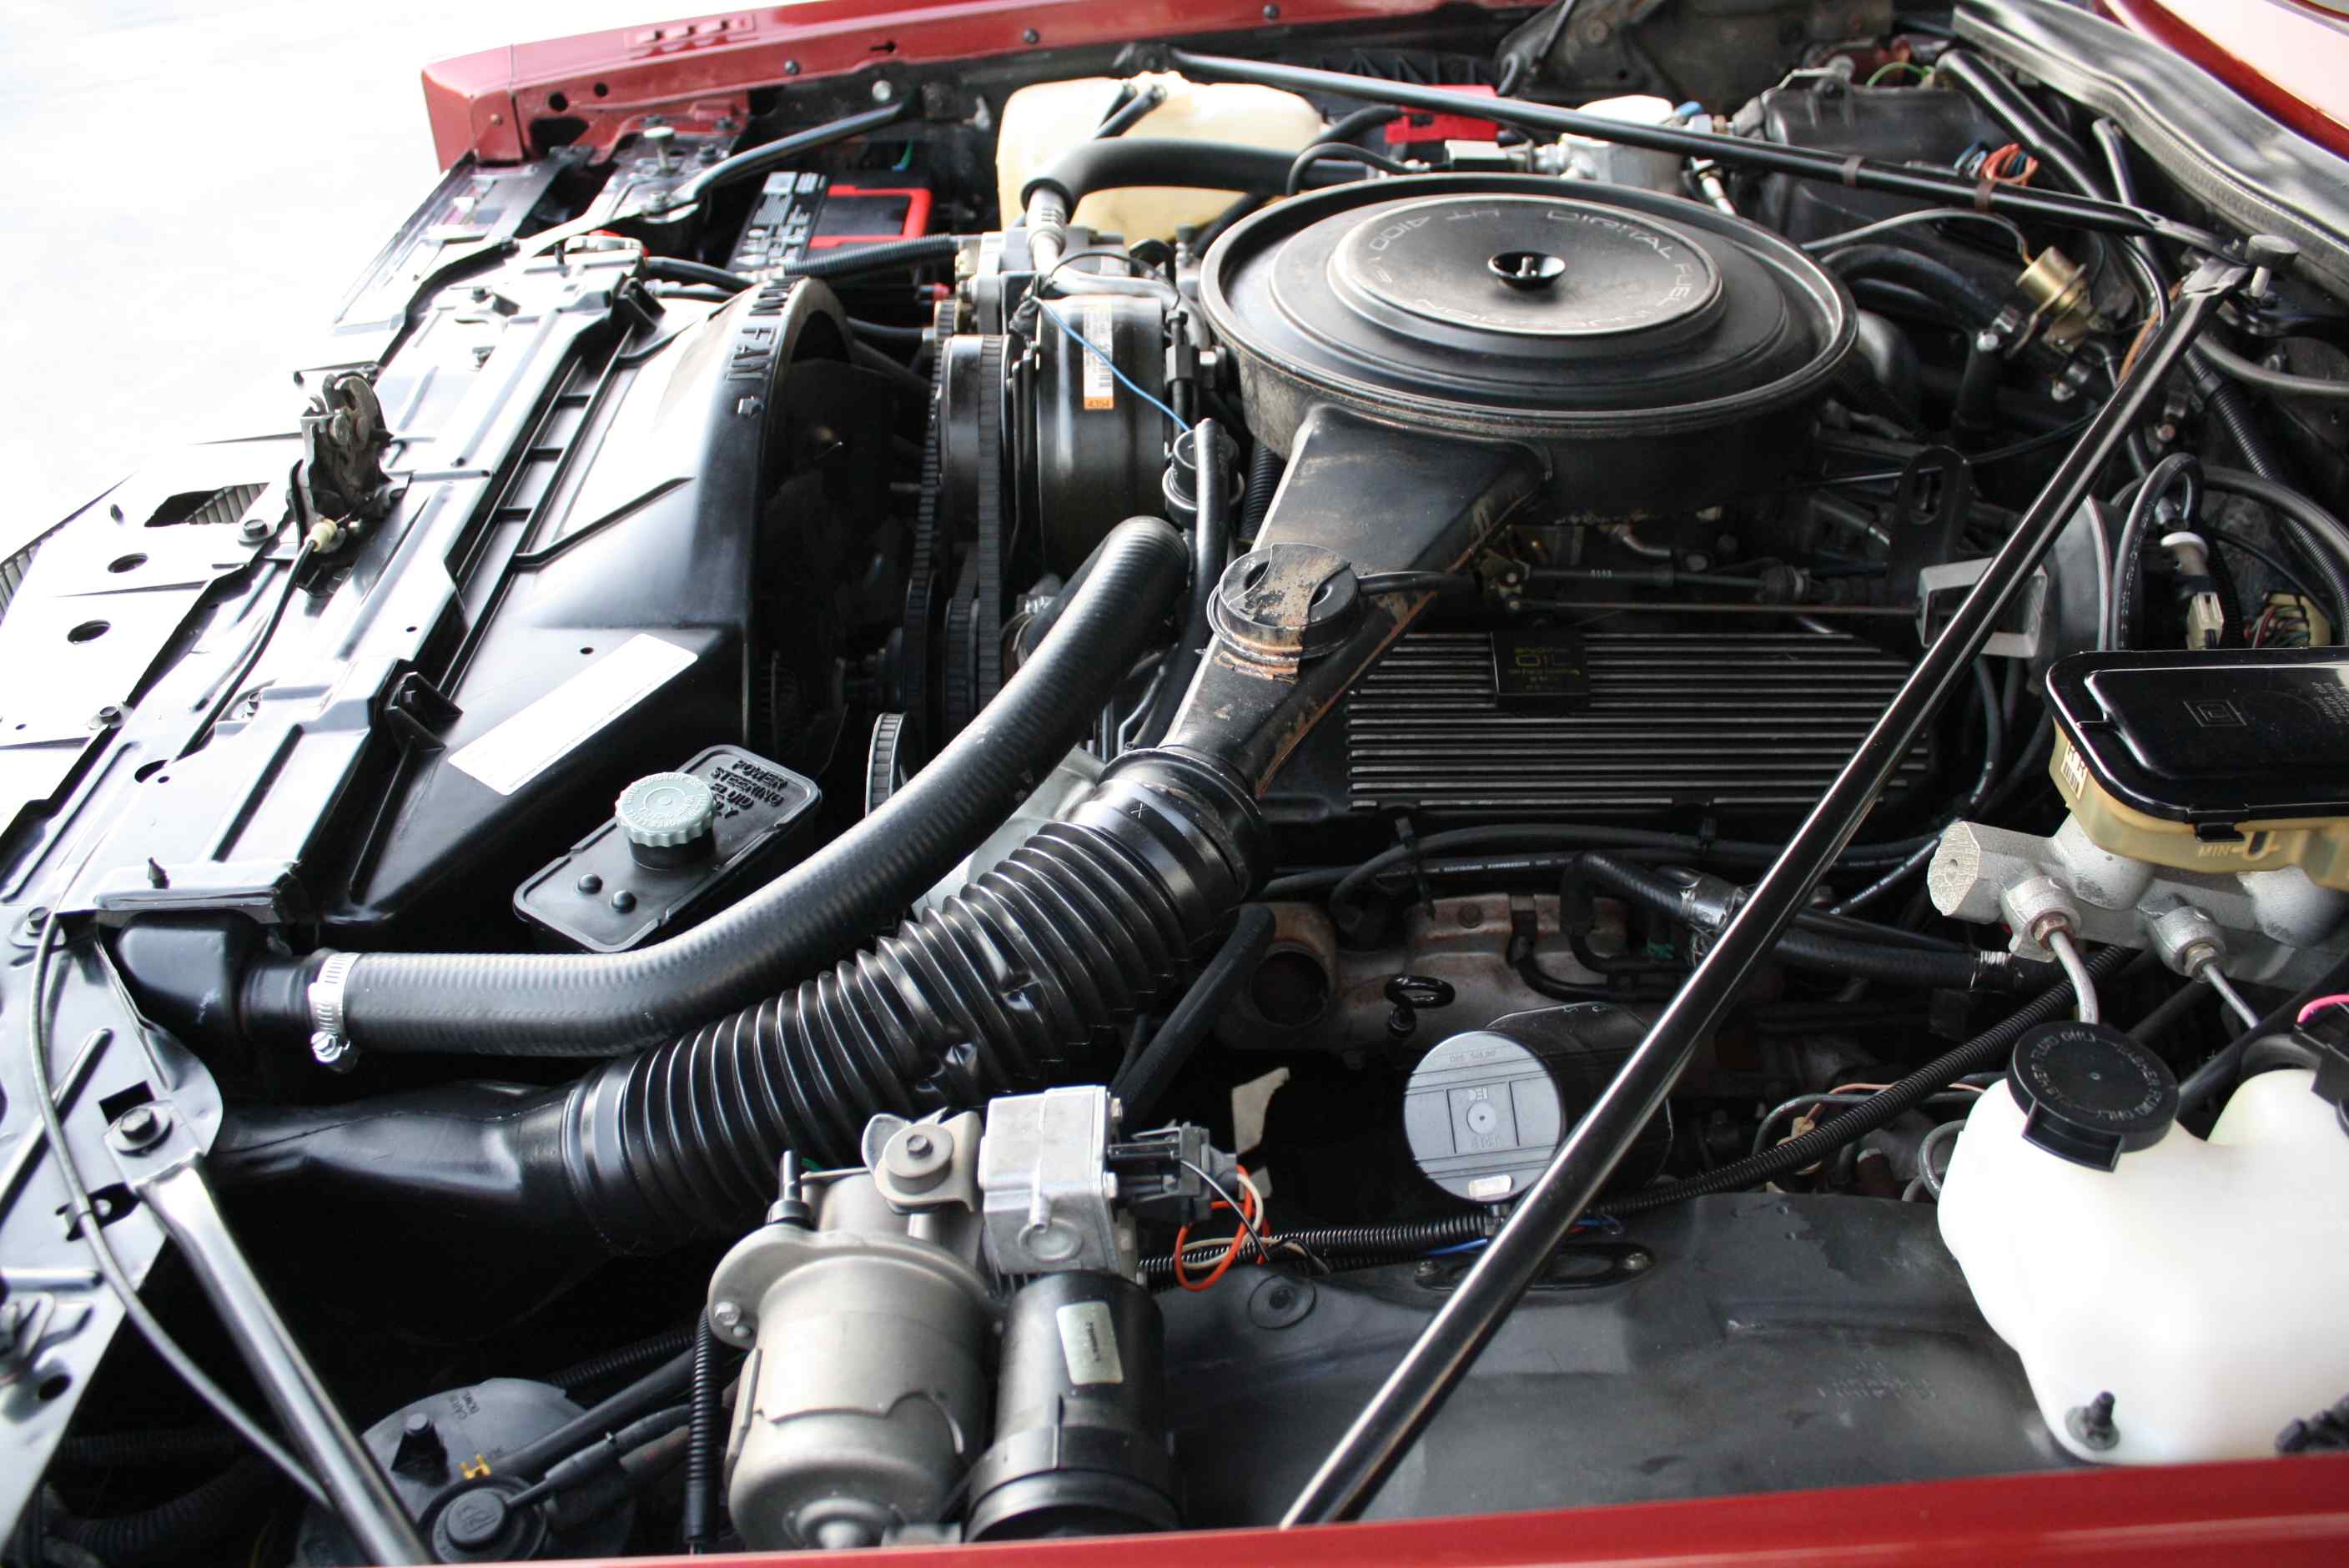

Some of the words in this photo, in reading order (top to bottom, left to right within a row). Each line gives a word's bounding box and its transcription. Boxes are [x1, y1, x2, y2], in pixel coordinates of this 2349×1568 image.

[1547, 210, 1672, 260] DIGITAL
[1655, 262, 1693, 307] FUEL
[711, 766, 784, 807] STEERING
[732, 760, 787, 791] POWER
[2198, 844, 2231, 858] MIN
